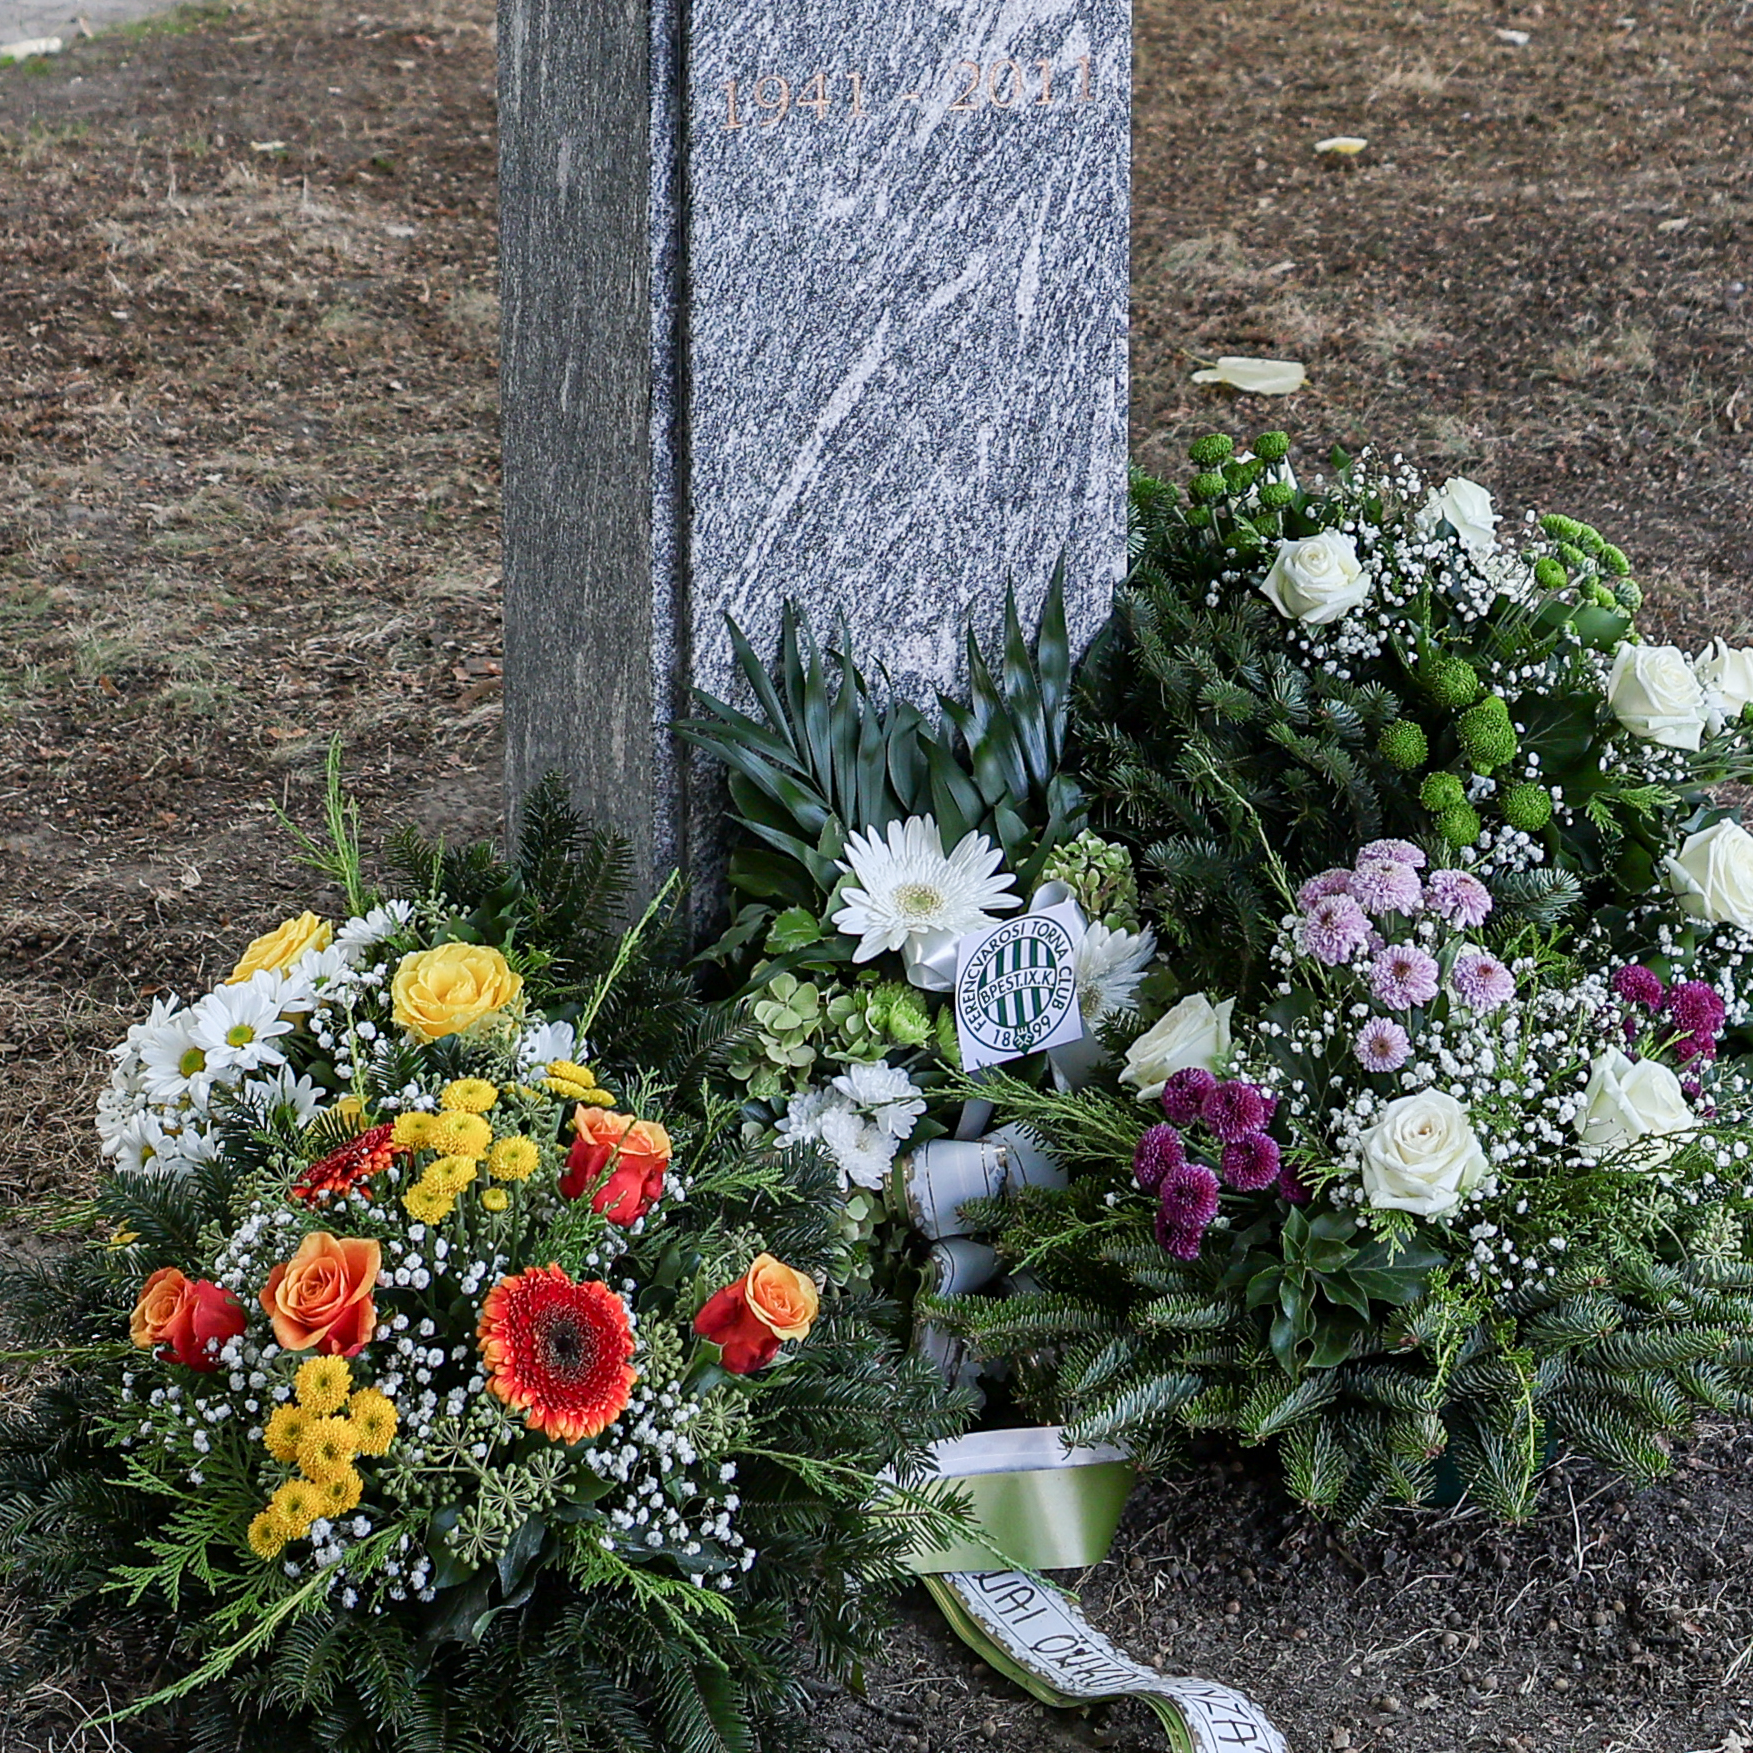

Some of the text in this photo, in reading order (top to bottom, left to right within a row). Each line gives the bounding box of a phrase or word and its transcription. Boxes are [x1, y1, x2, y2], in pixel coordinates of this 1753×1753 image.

[721, 72, 866, 131] 1941
[948, 54, 1096, 112] 2011
[1031, 921, 1069, 962] TORNA
[1052, 965, 1073, 1011] CLUB
